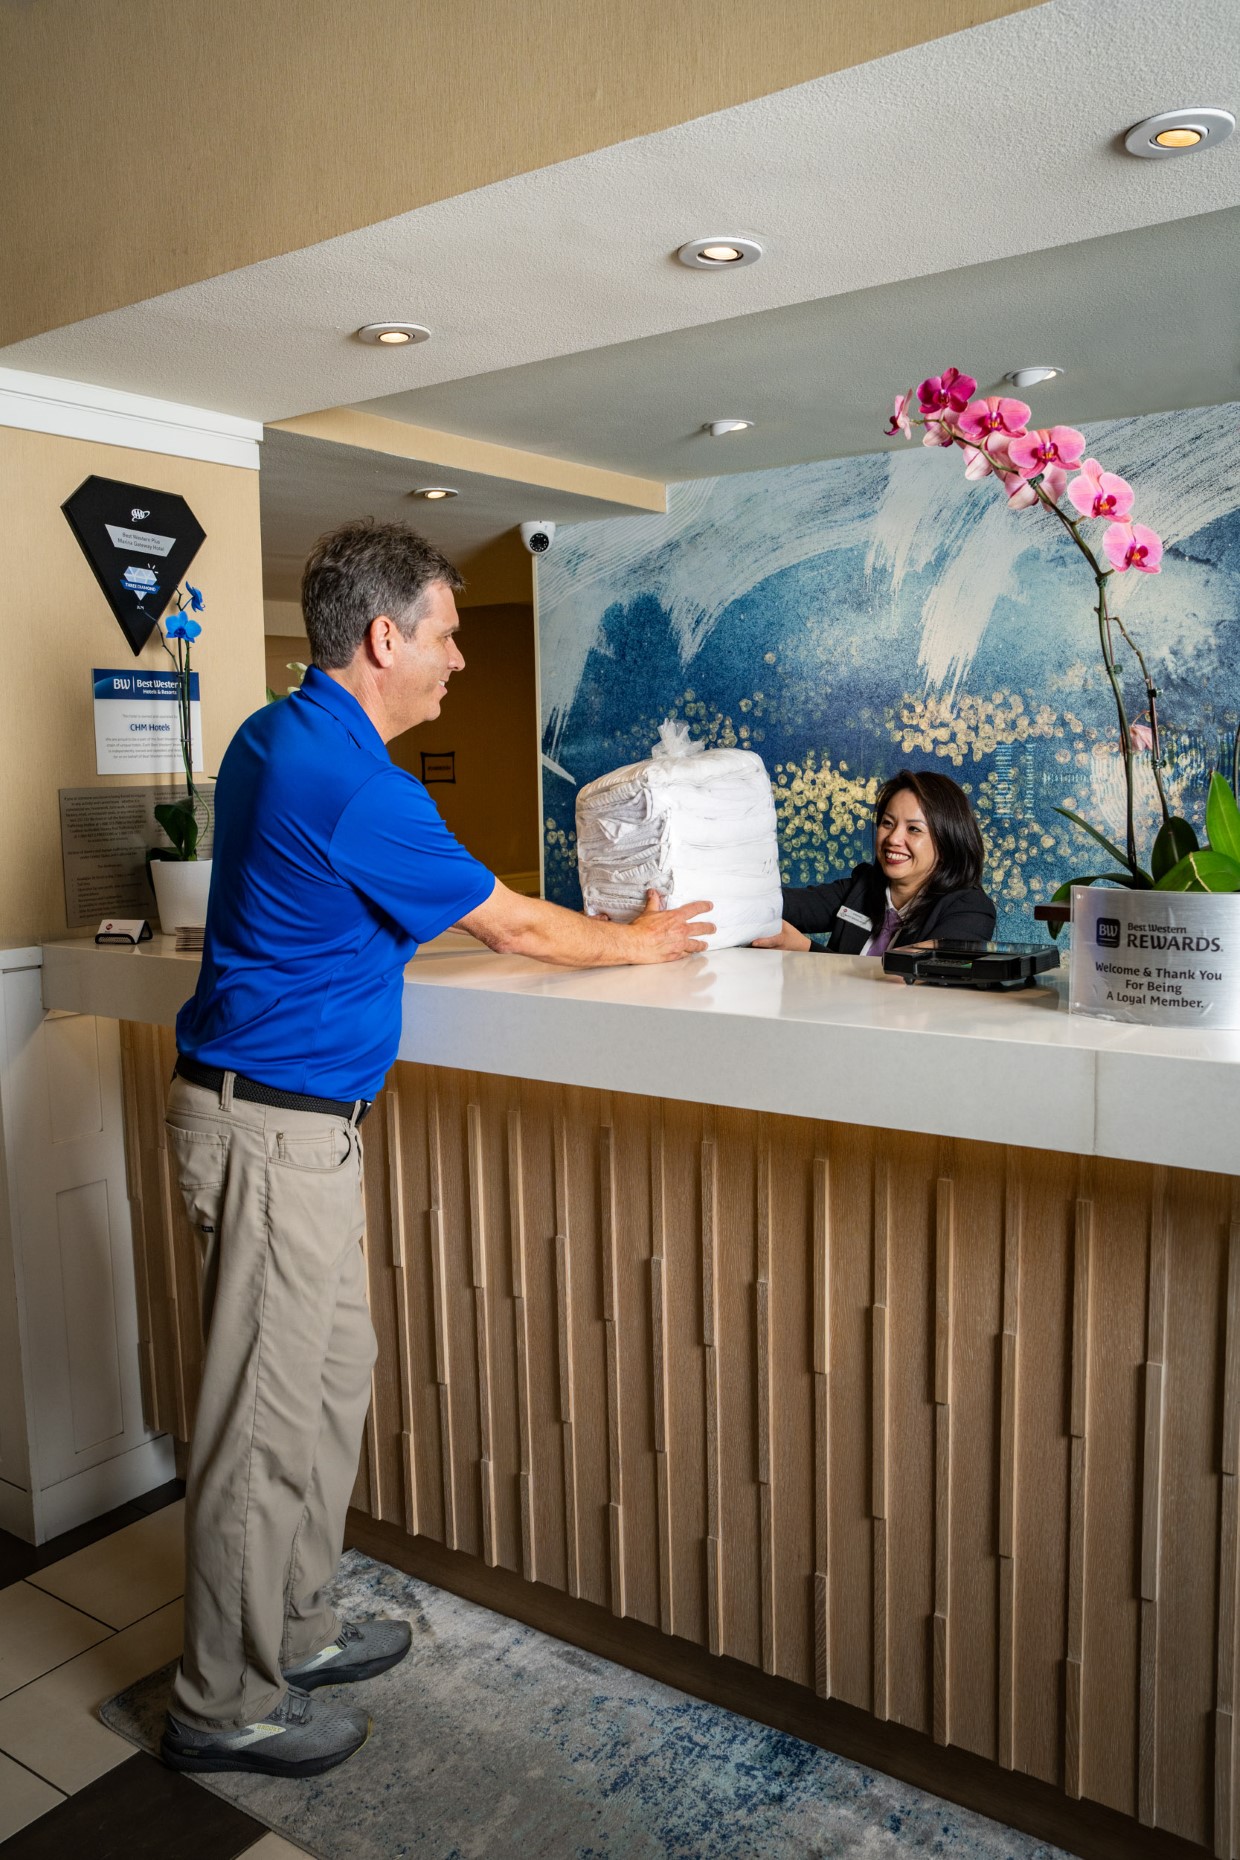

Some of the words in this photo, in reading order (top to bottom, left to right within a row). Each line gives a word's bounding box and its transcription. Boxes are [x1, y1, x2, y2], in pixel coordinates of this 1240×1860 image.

[117, 537, 133, 546] Marina
[133, 541, 152, 551] Gateway
[132, 534, 150, 542] Western
[151, 537, 160, 545] Plus
[113, 678, 131, 690] BW
[136, 679, 153, 688] Best
[129, 723, 148, 732] CHM
[148, 723, 171, 732] Hotels
[1099, 923, 1119, 937] BW
[1127, 922, 1146, 932] Best
[1148, 923, 1187, 934] Western
[1095, 961, 1140, 976] Welcome
[1142, 967, 1153, 978] &
[1155, 967, 1195, 980] Thank
[1199, 969, 1223, 981] You
[1125, 979, 1144, 990] For
[1147, 981, 1182, 995] Being
[1106, 991, 1114, 1001] A
[1116, 992, 1146, 1005] Loyal
[1149, 997, 1204, 1009] Member.
